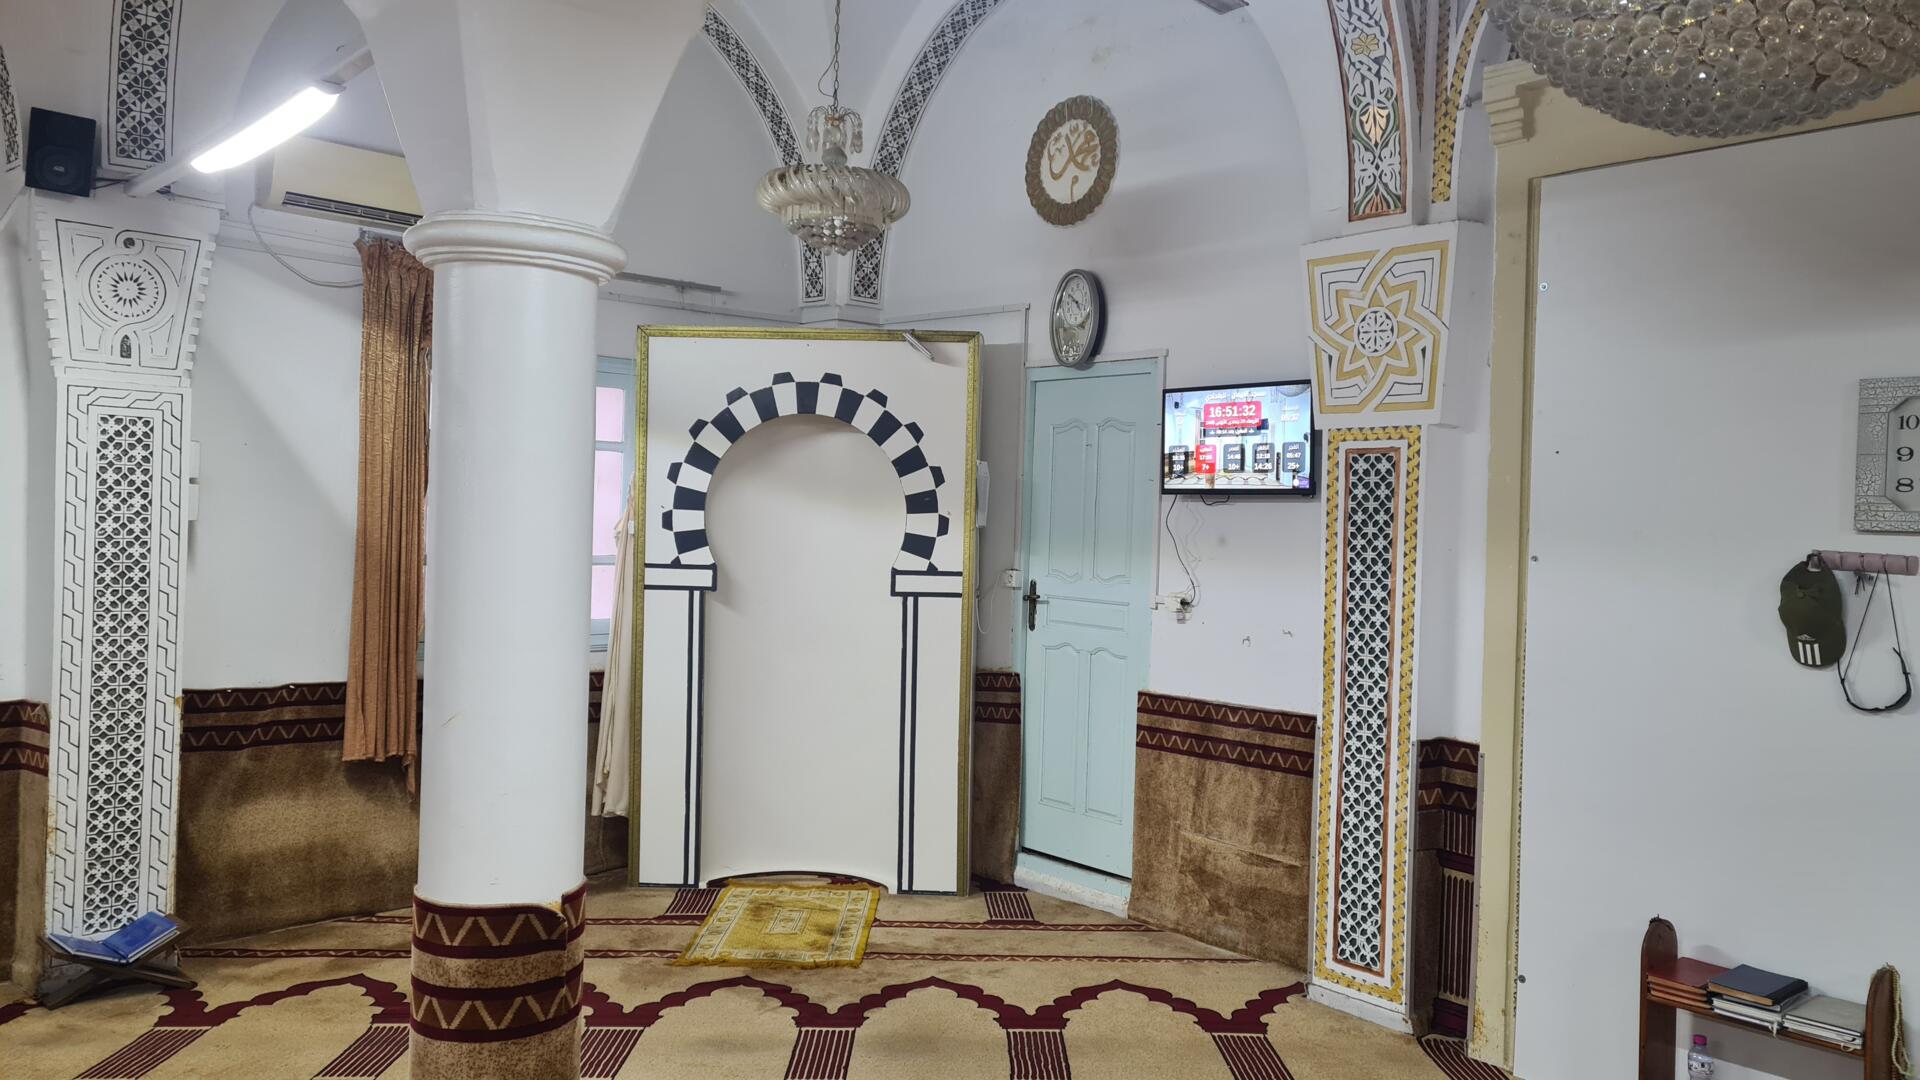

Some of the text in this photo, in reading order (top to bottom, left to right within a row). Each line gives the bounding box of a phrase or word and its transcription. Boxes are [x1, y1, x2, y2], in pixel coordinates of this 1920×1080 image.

[1209, 405, 1256, 418] 16:51:32
[1898, 414, 1920, 430] 10
[1897, 447, 1914, 462] 9
[1228, 463, 1240, 471] 10+
[1287, 462, 1300, 470] 25+
[1896, 478, 1914, 492] 8
